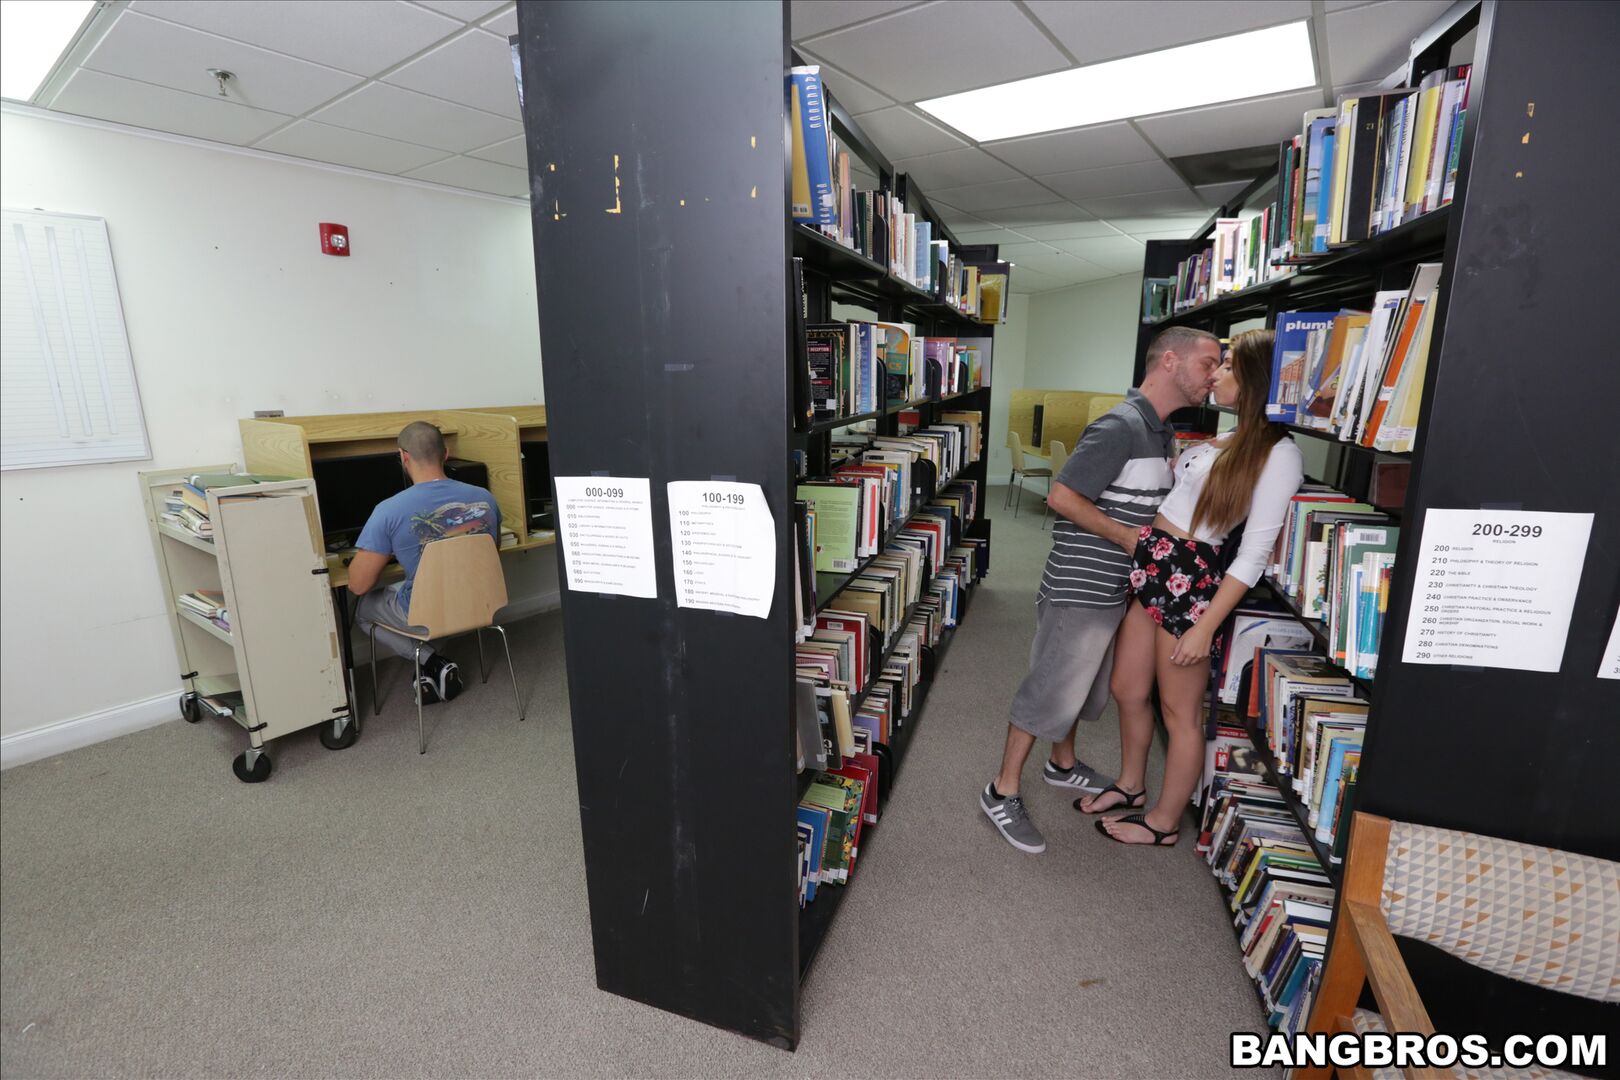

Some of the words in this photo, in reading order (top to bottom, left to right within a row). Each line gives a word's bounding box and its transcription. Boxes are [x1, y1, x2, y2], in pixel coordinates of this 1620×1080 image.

[586, 487, 624, 498] 000-099
[702, 492, 745, 505] 100-199
[1472, 524, 1542, 537] 200-299
